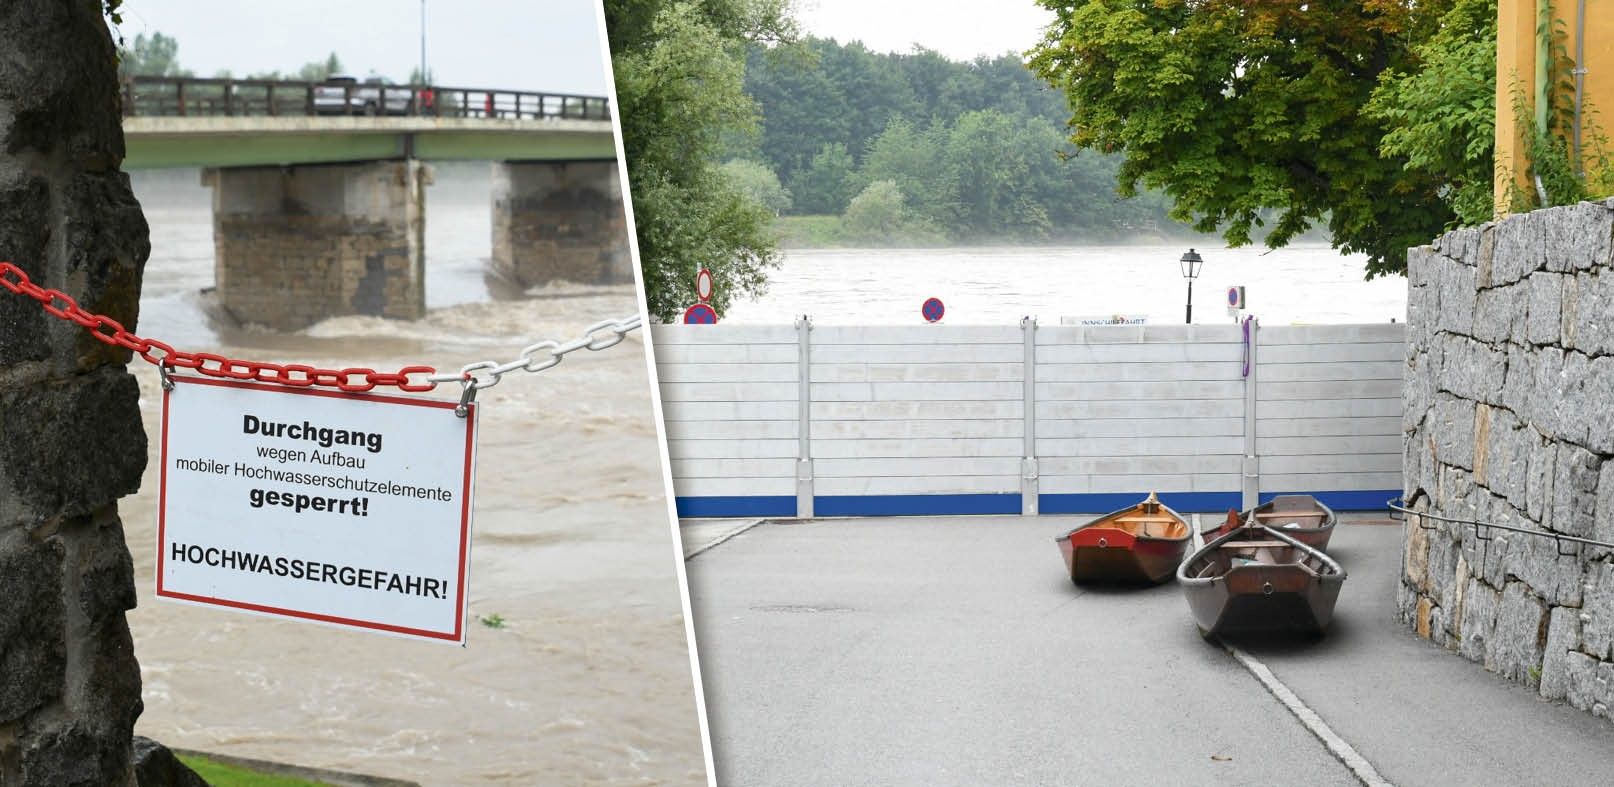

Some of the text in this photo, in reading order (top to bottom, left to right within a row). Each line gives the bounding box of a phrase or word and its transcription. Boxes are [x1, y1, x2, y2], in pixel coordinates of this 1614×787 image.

[243, 414, 383, 453] Durchgang
[256, 446, 366, 469] wegen Aufbau
[176, 457, 453, 502] mobiler Hochwasserschutzelemente
[249, 488, 369, 516] gesperrt!
[171, 542, 448, 600] HOCHWASSERGEFAHR!
